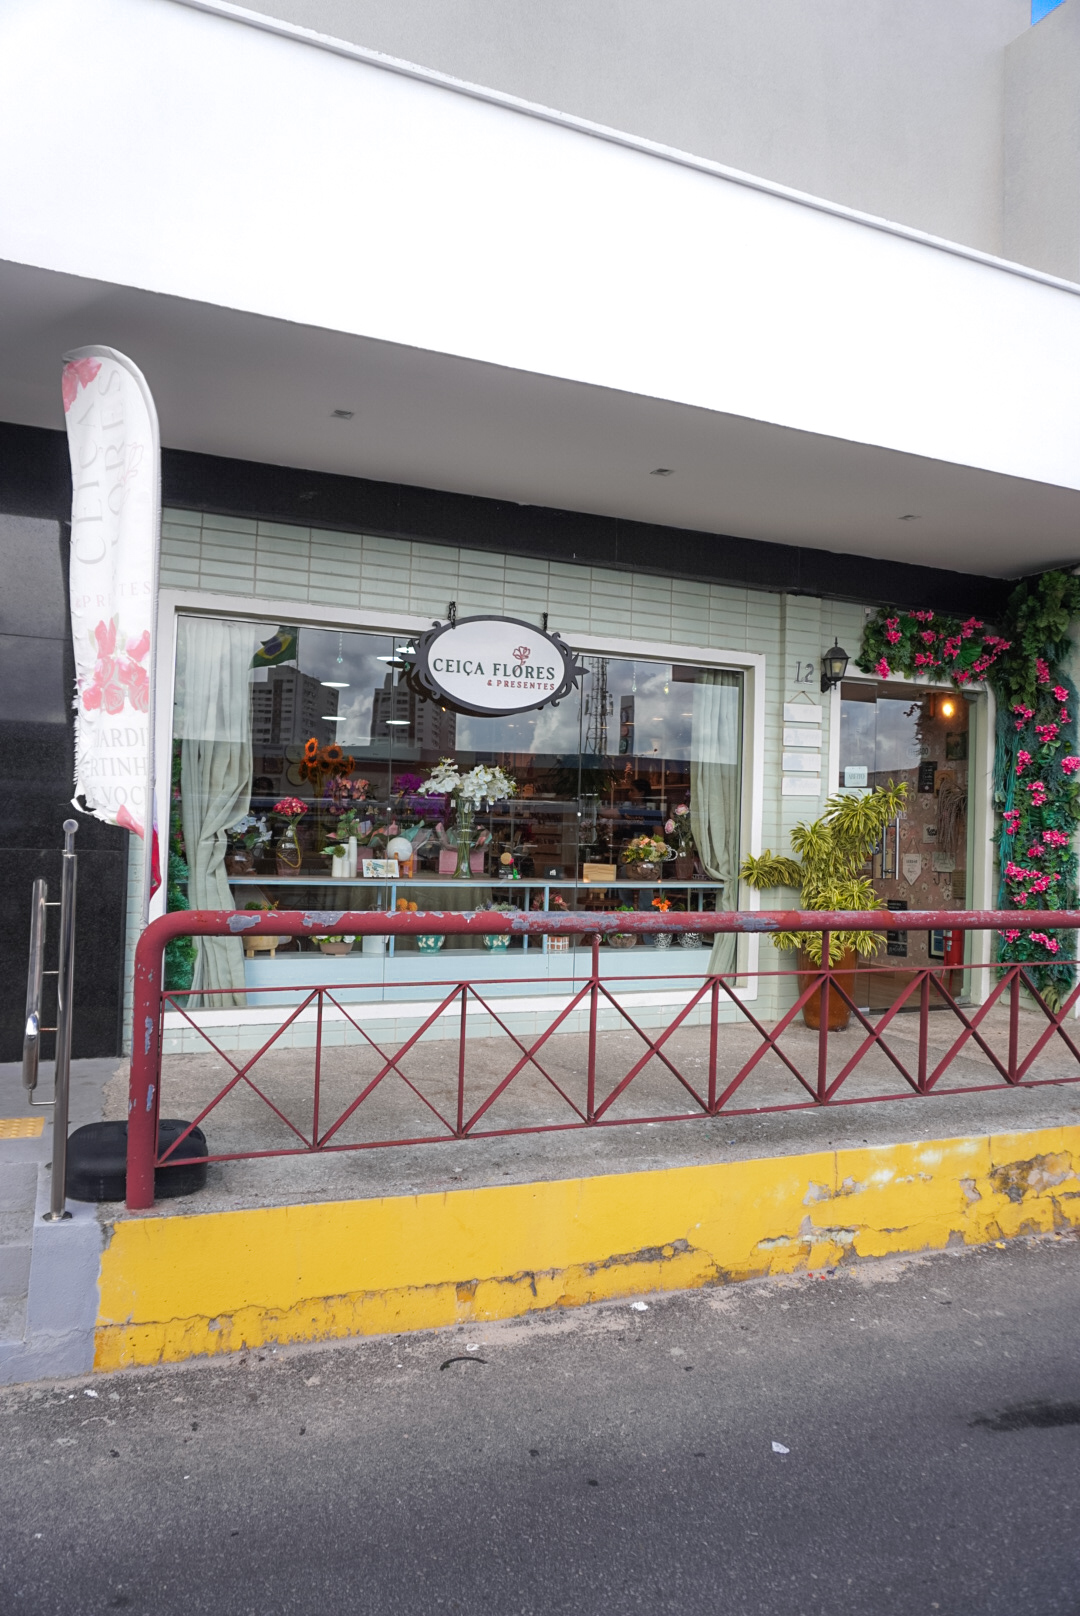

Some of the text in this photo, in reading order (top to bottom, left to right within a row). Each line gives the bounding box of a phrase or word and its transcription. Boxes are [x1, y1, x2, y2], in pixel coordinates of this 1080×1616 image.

[433, 658, 555, 680] CEIÇA FLORES
[496, 680, 555, 690] PRESENTES
